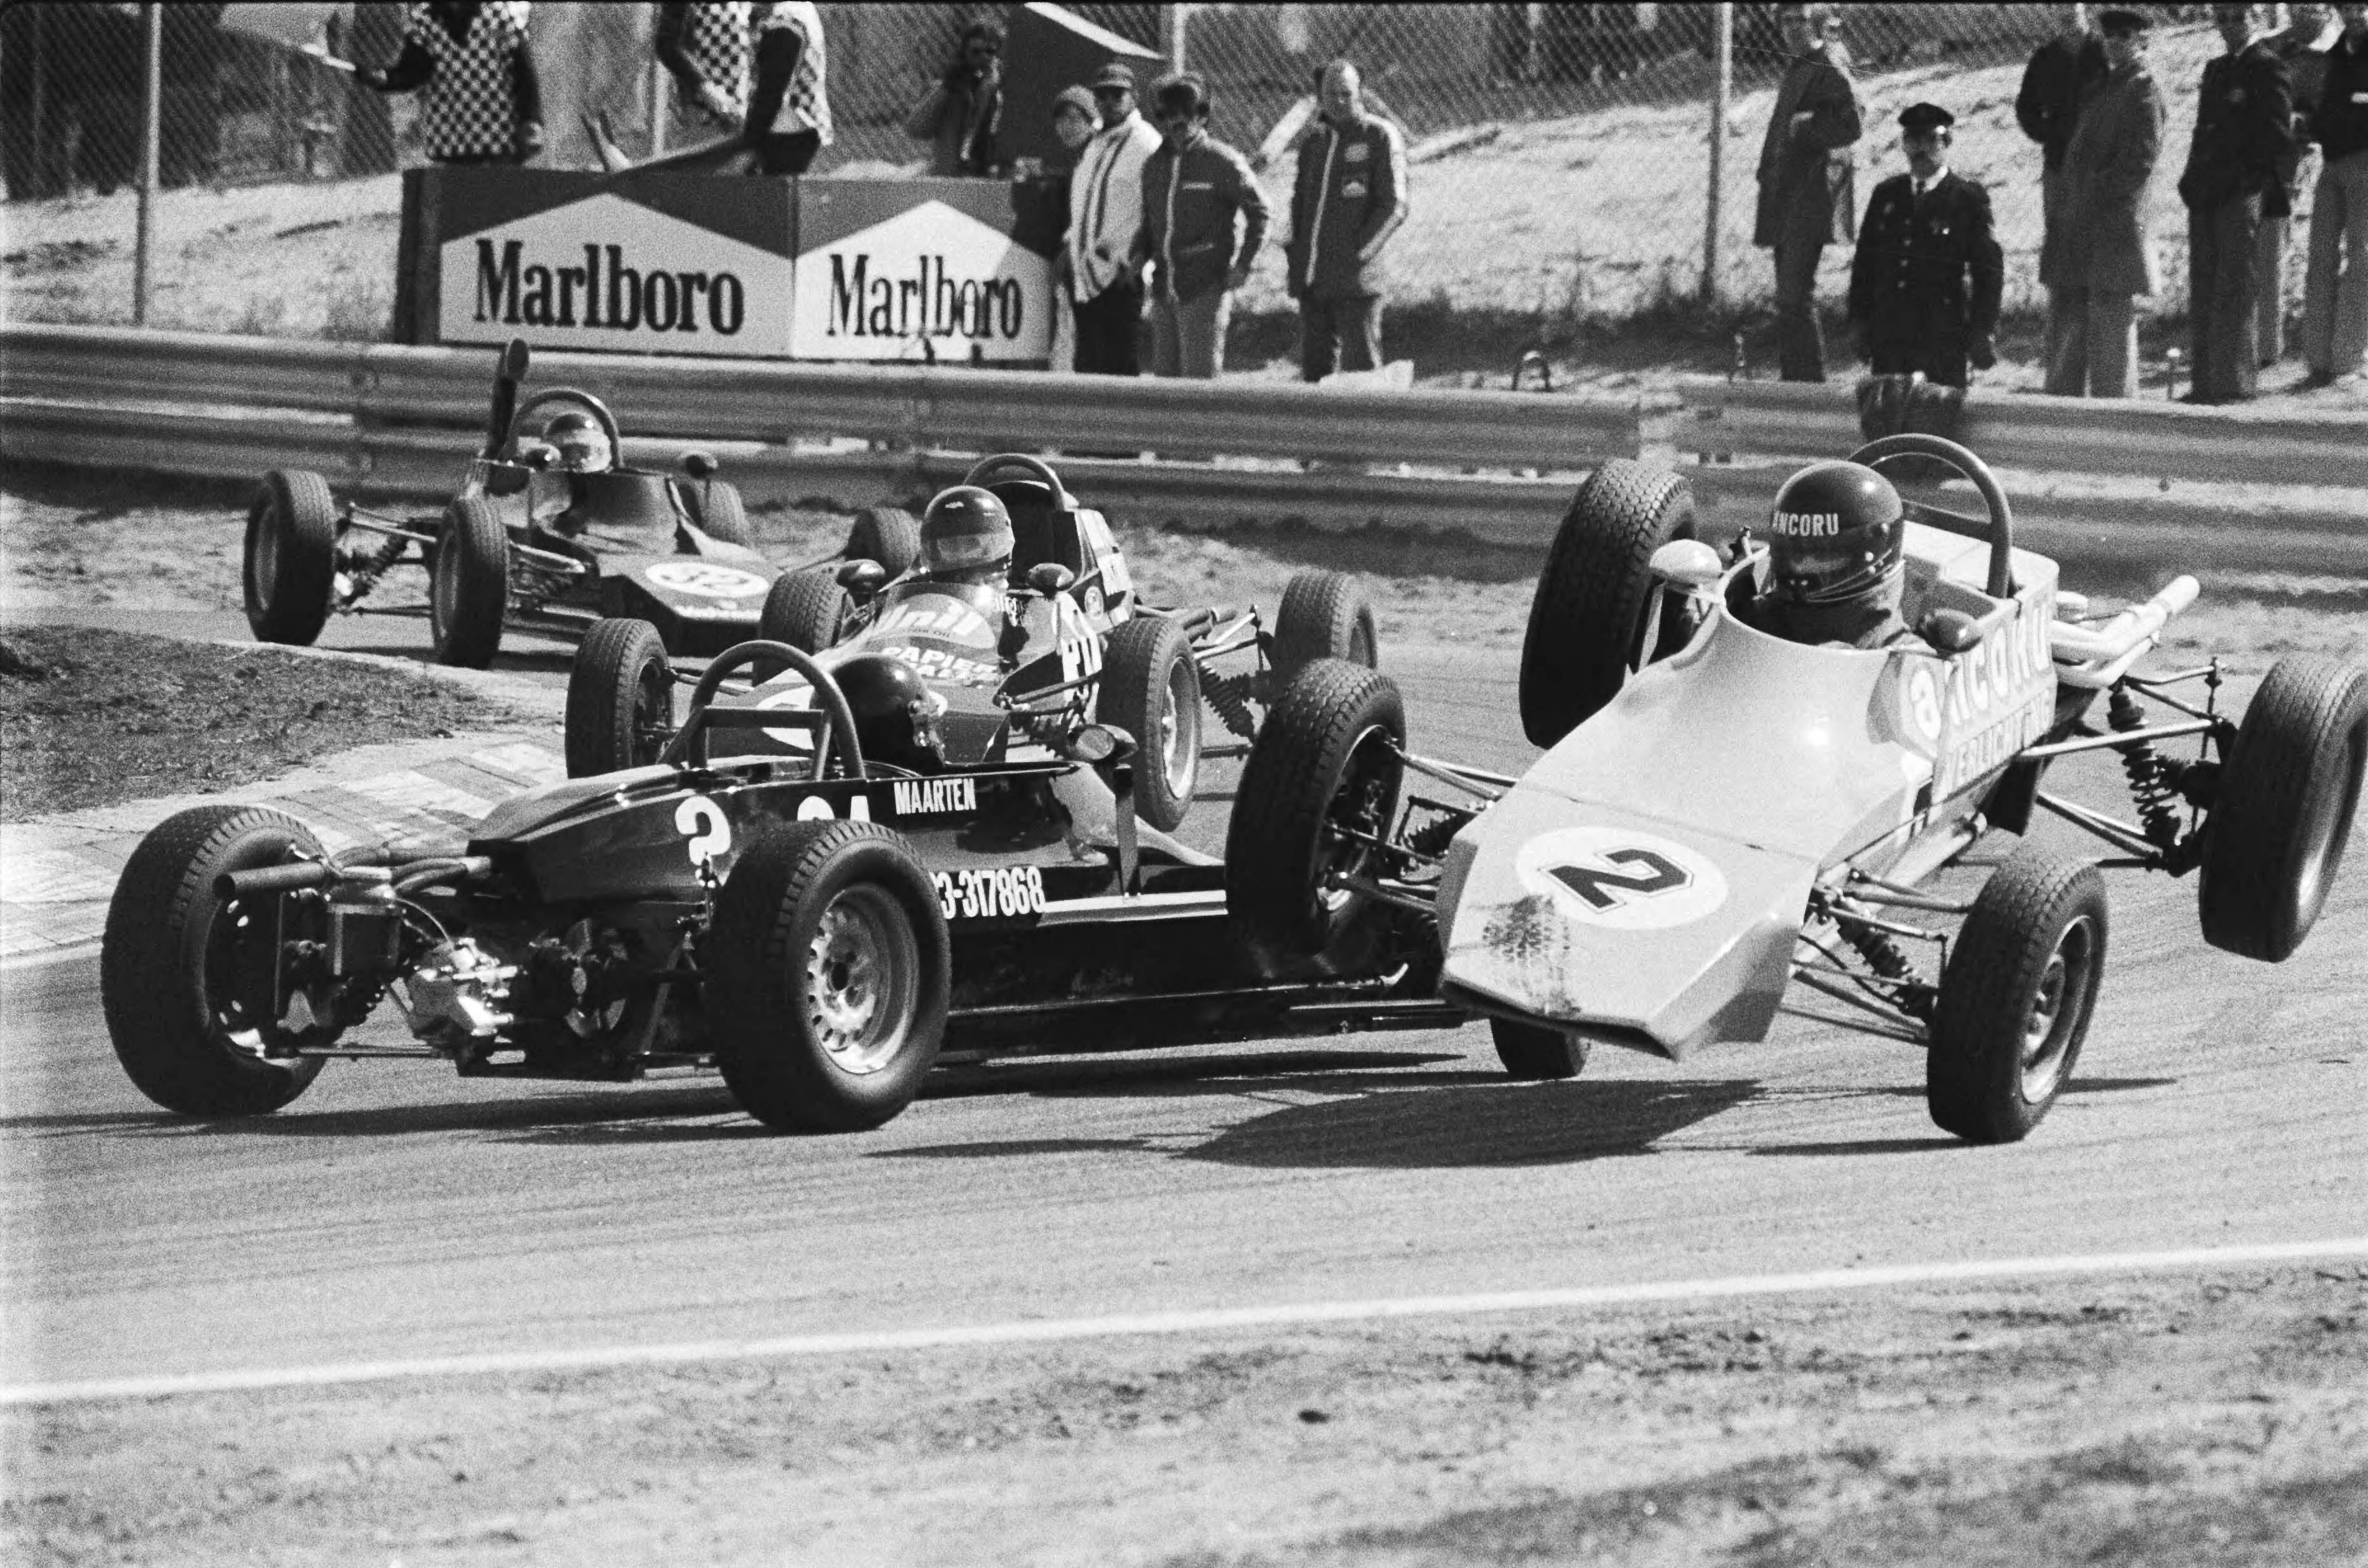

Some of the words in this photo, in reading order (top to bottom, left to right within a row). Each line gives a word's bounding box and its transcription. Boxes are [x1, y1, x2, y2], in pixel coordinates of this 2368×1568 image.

[472, 238, 744, 336] Marlboro
[825, 254, 1020, 339] Marlboro
[893, 778, 977, 815] MAARTEN
[1540, 846, 1692, 911] 2
